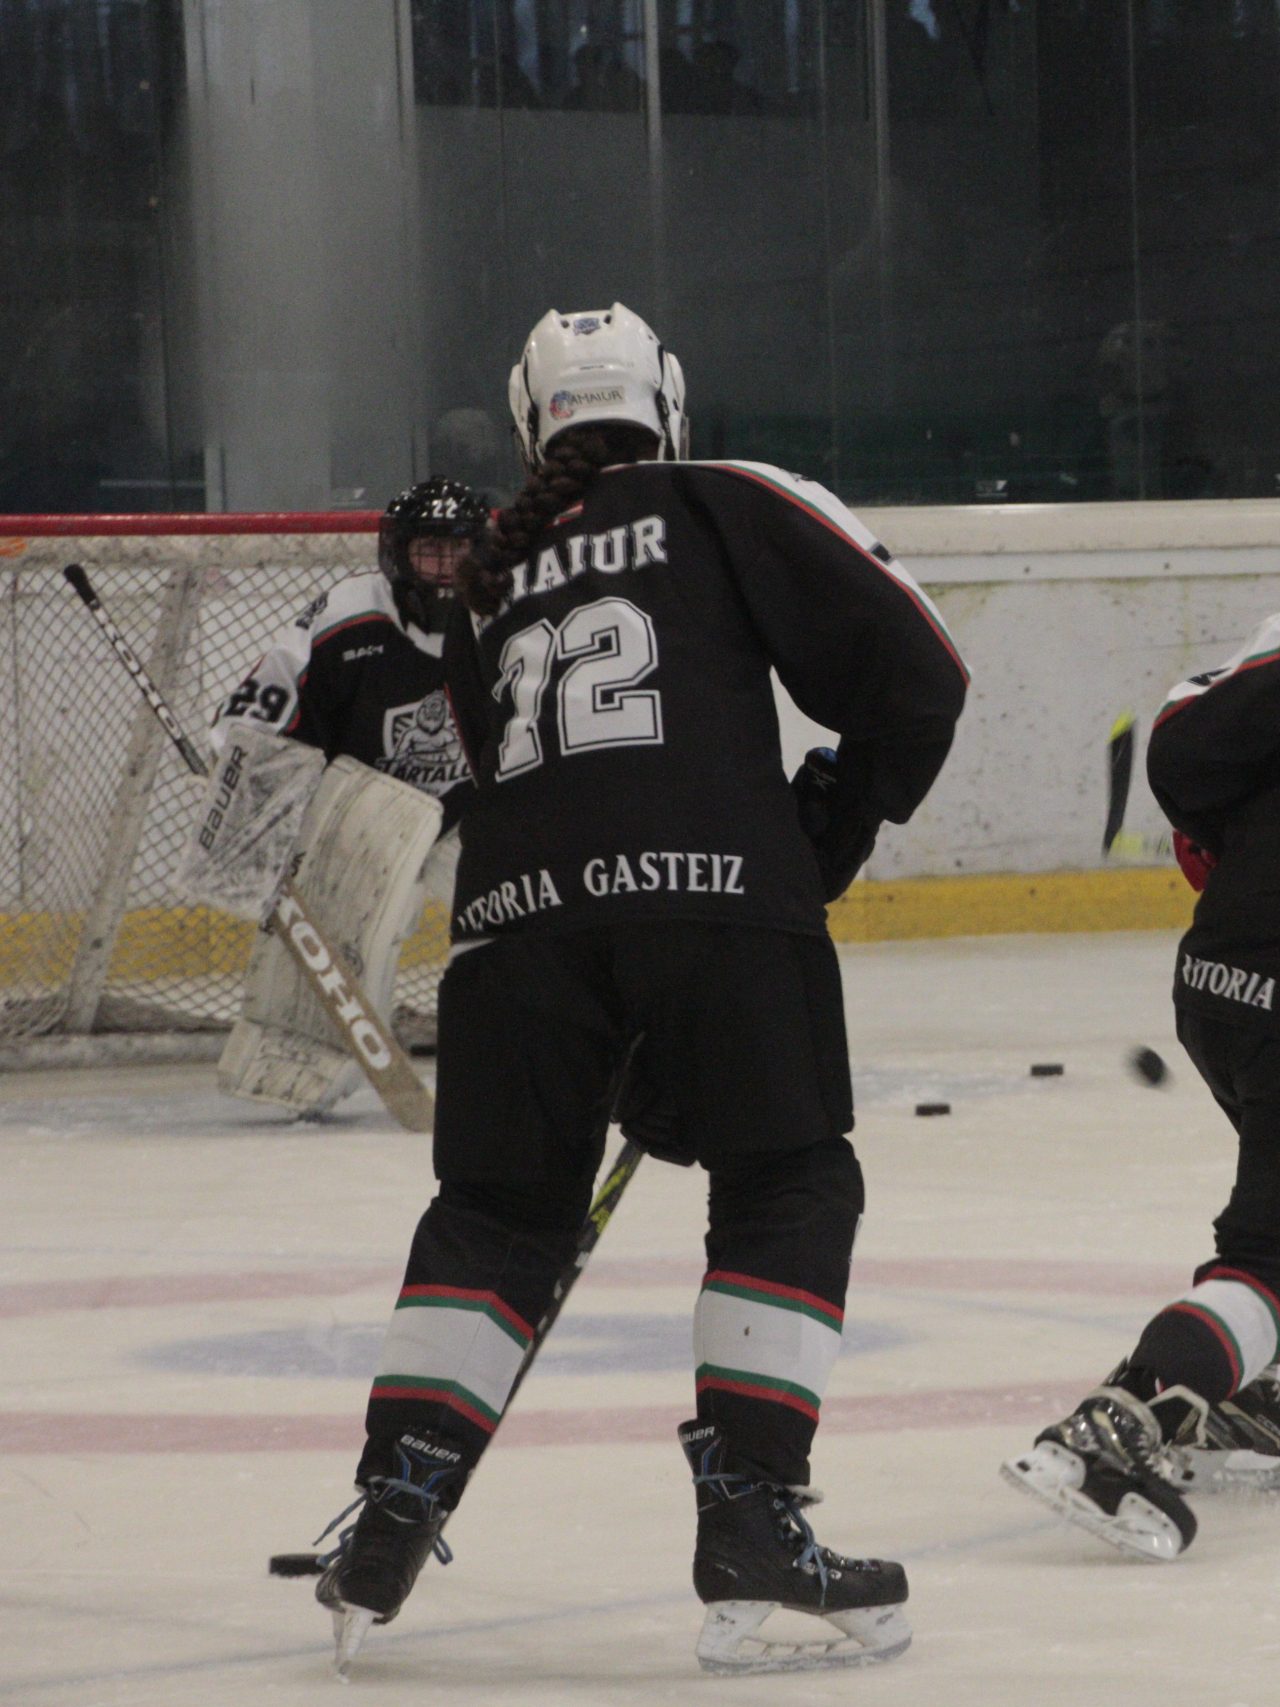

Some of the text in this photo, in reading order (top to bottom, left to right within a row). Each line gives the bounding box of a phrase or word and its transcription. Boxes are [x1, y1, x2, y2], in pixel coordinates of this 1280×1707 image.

[569, 388, 624, 405] AMAIUR
[431, 497, 458, 519] 22
[222, 679, 291, 723] 29
[491, 596, 664, 783] 12
[197, 744, 249, 850] BAUER
[583, 851, 745, 896] GASTEIZ
[400, 1433, 461, 1464] BAUER
